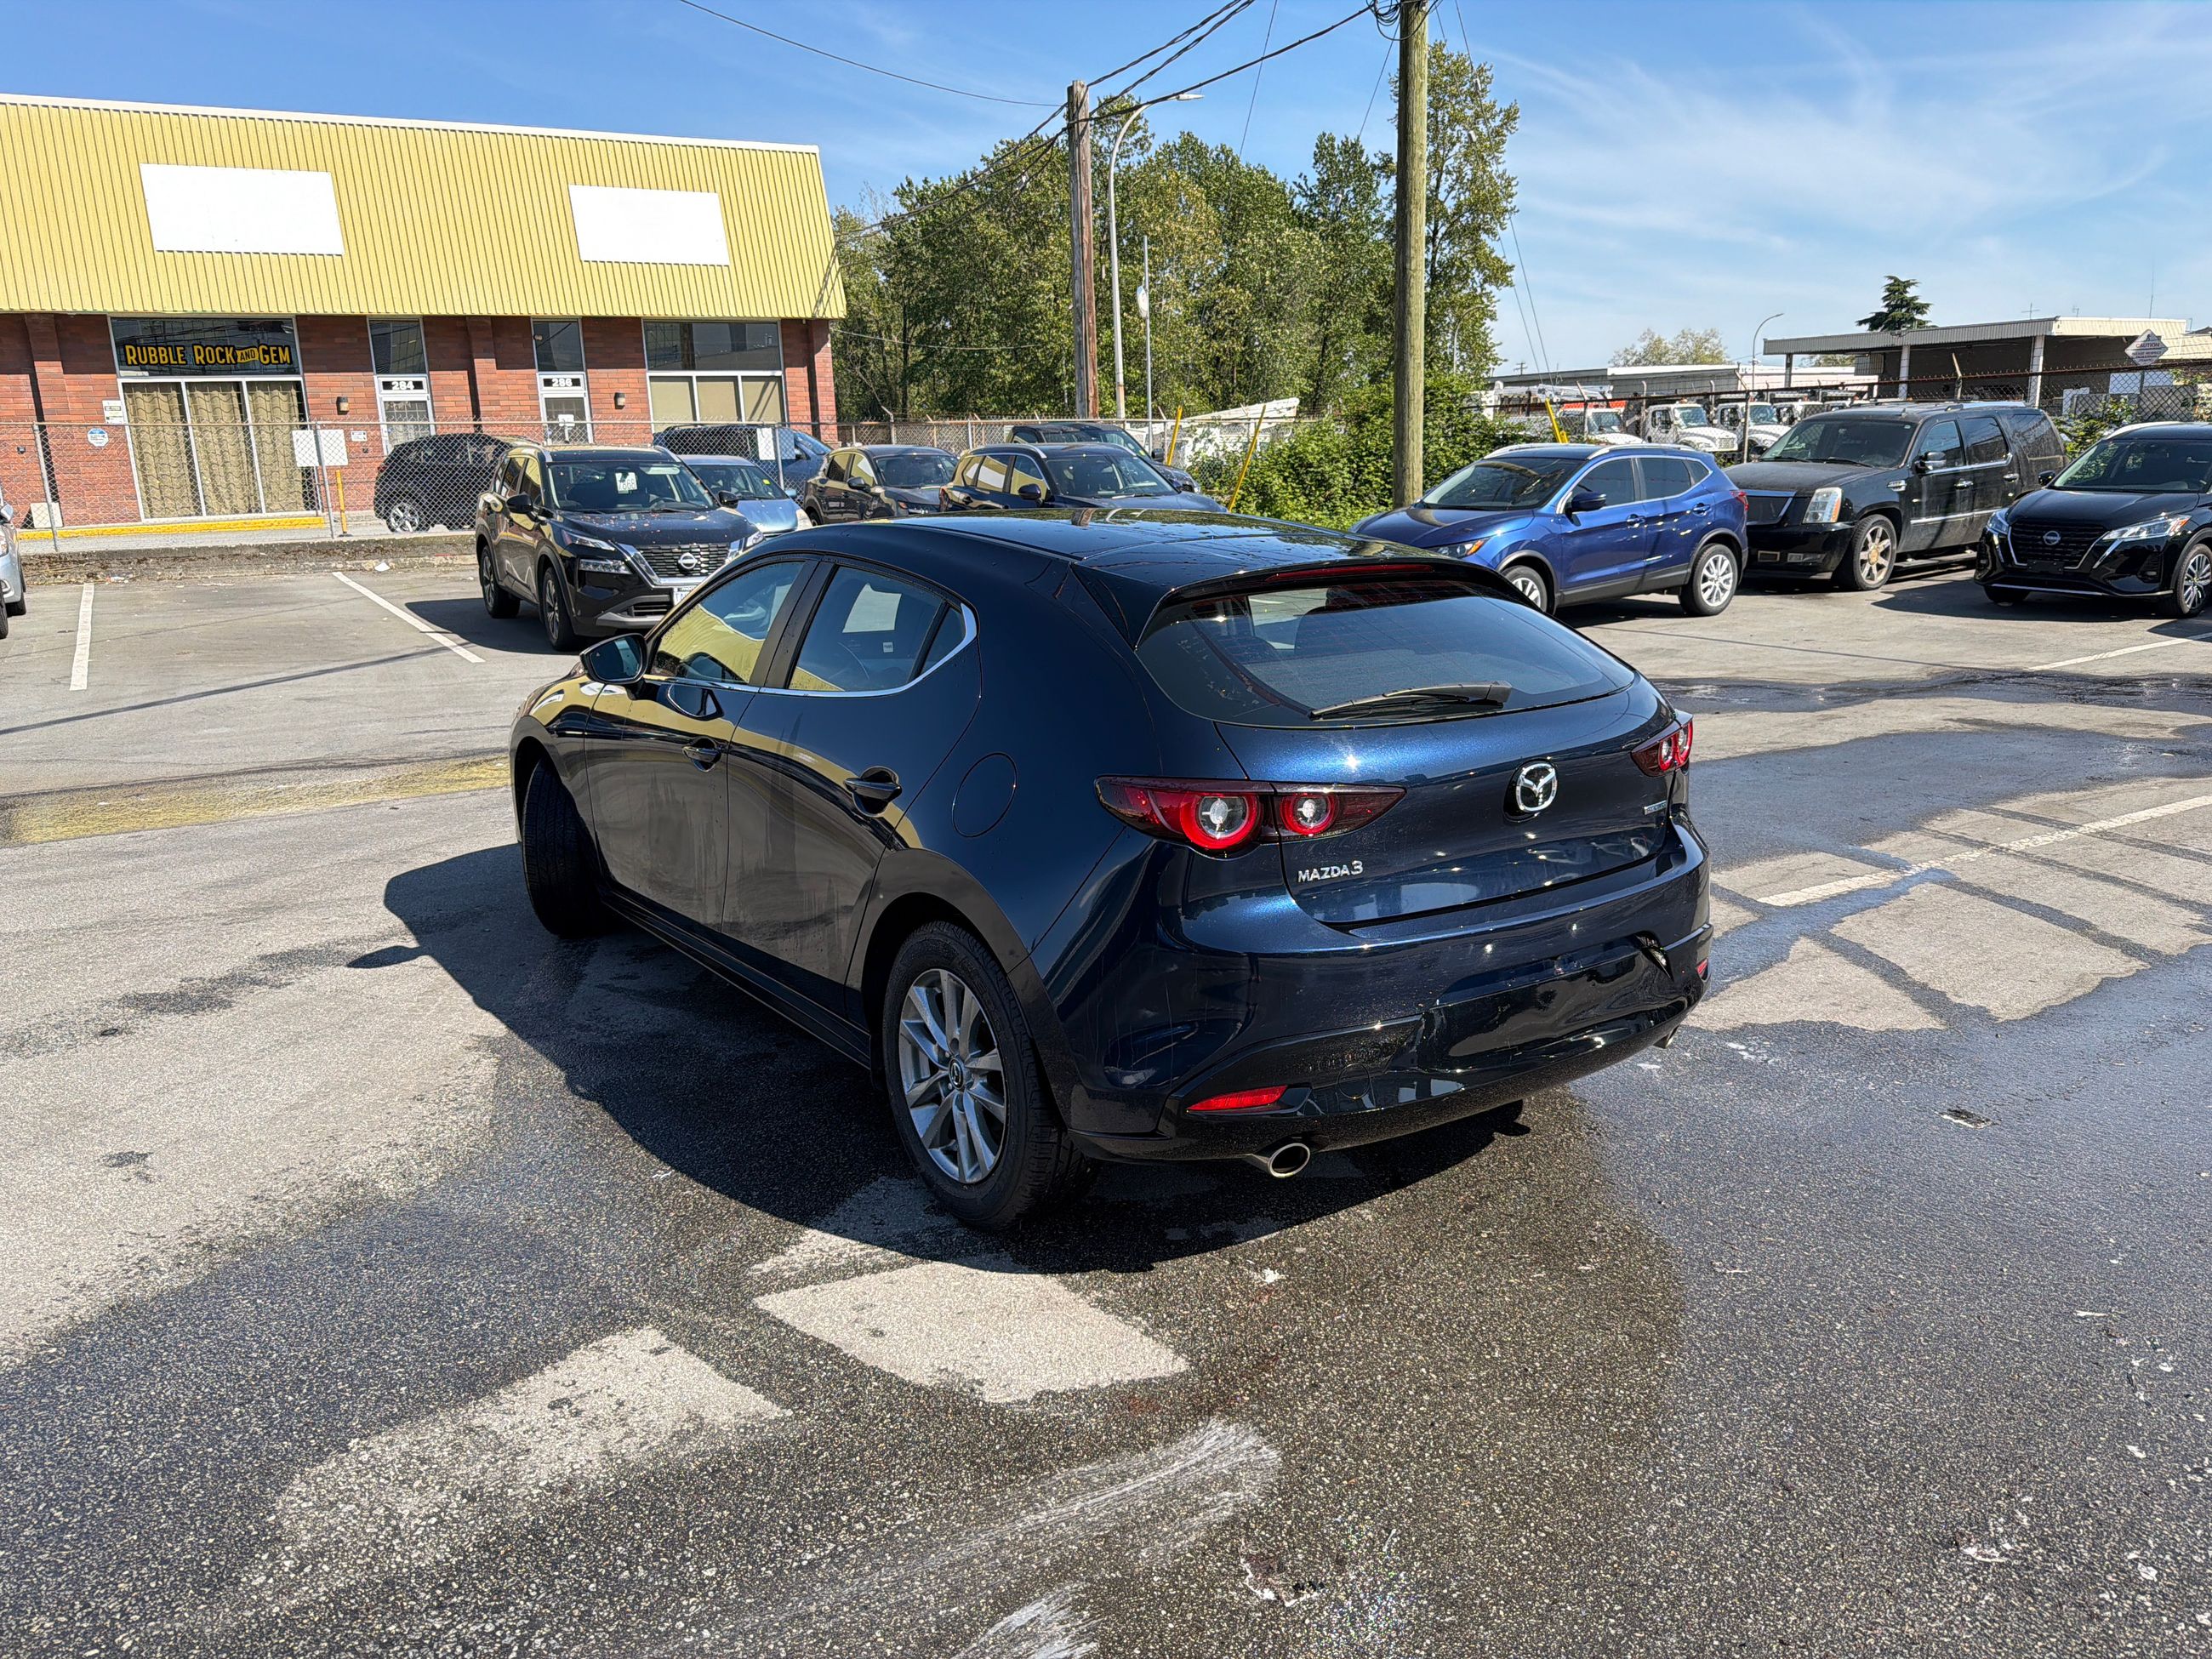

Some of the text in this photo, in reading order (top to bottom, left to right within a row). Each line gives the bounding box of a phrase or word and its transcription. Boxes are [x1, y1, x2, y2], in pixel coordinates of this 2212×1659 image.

[124, 344, 292, 366] RUBBLE ROCK AND GEM
[391, 380, 414, 390] 284
[551, 378, 573, 387] 286
